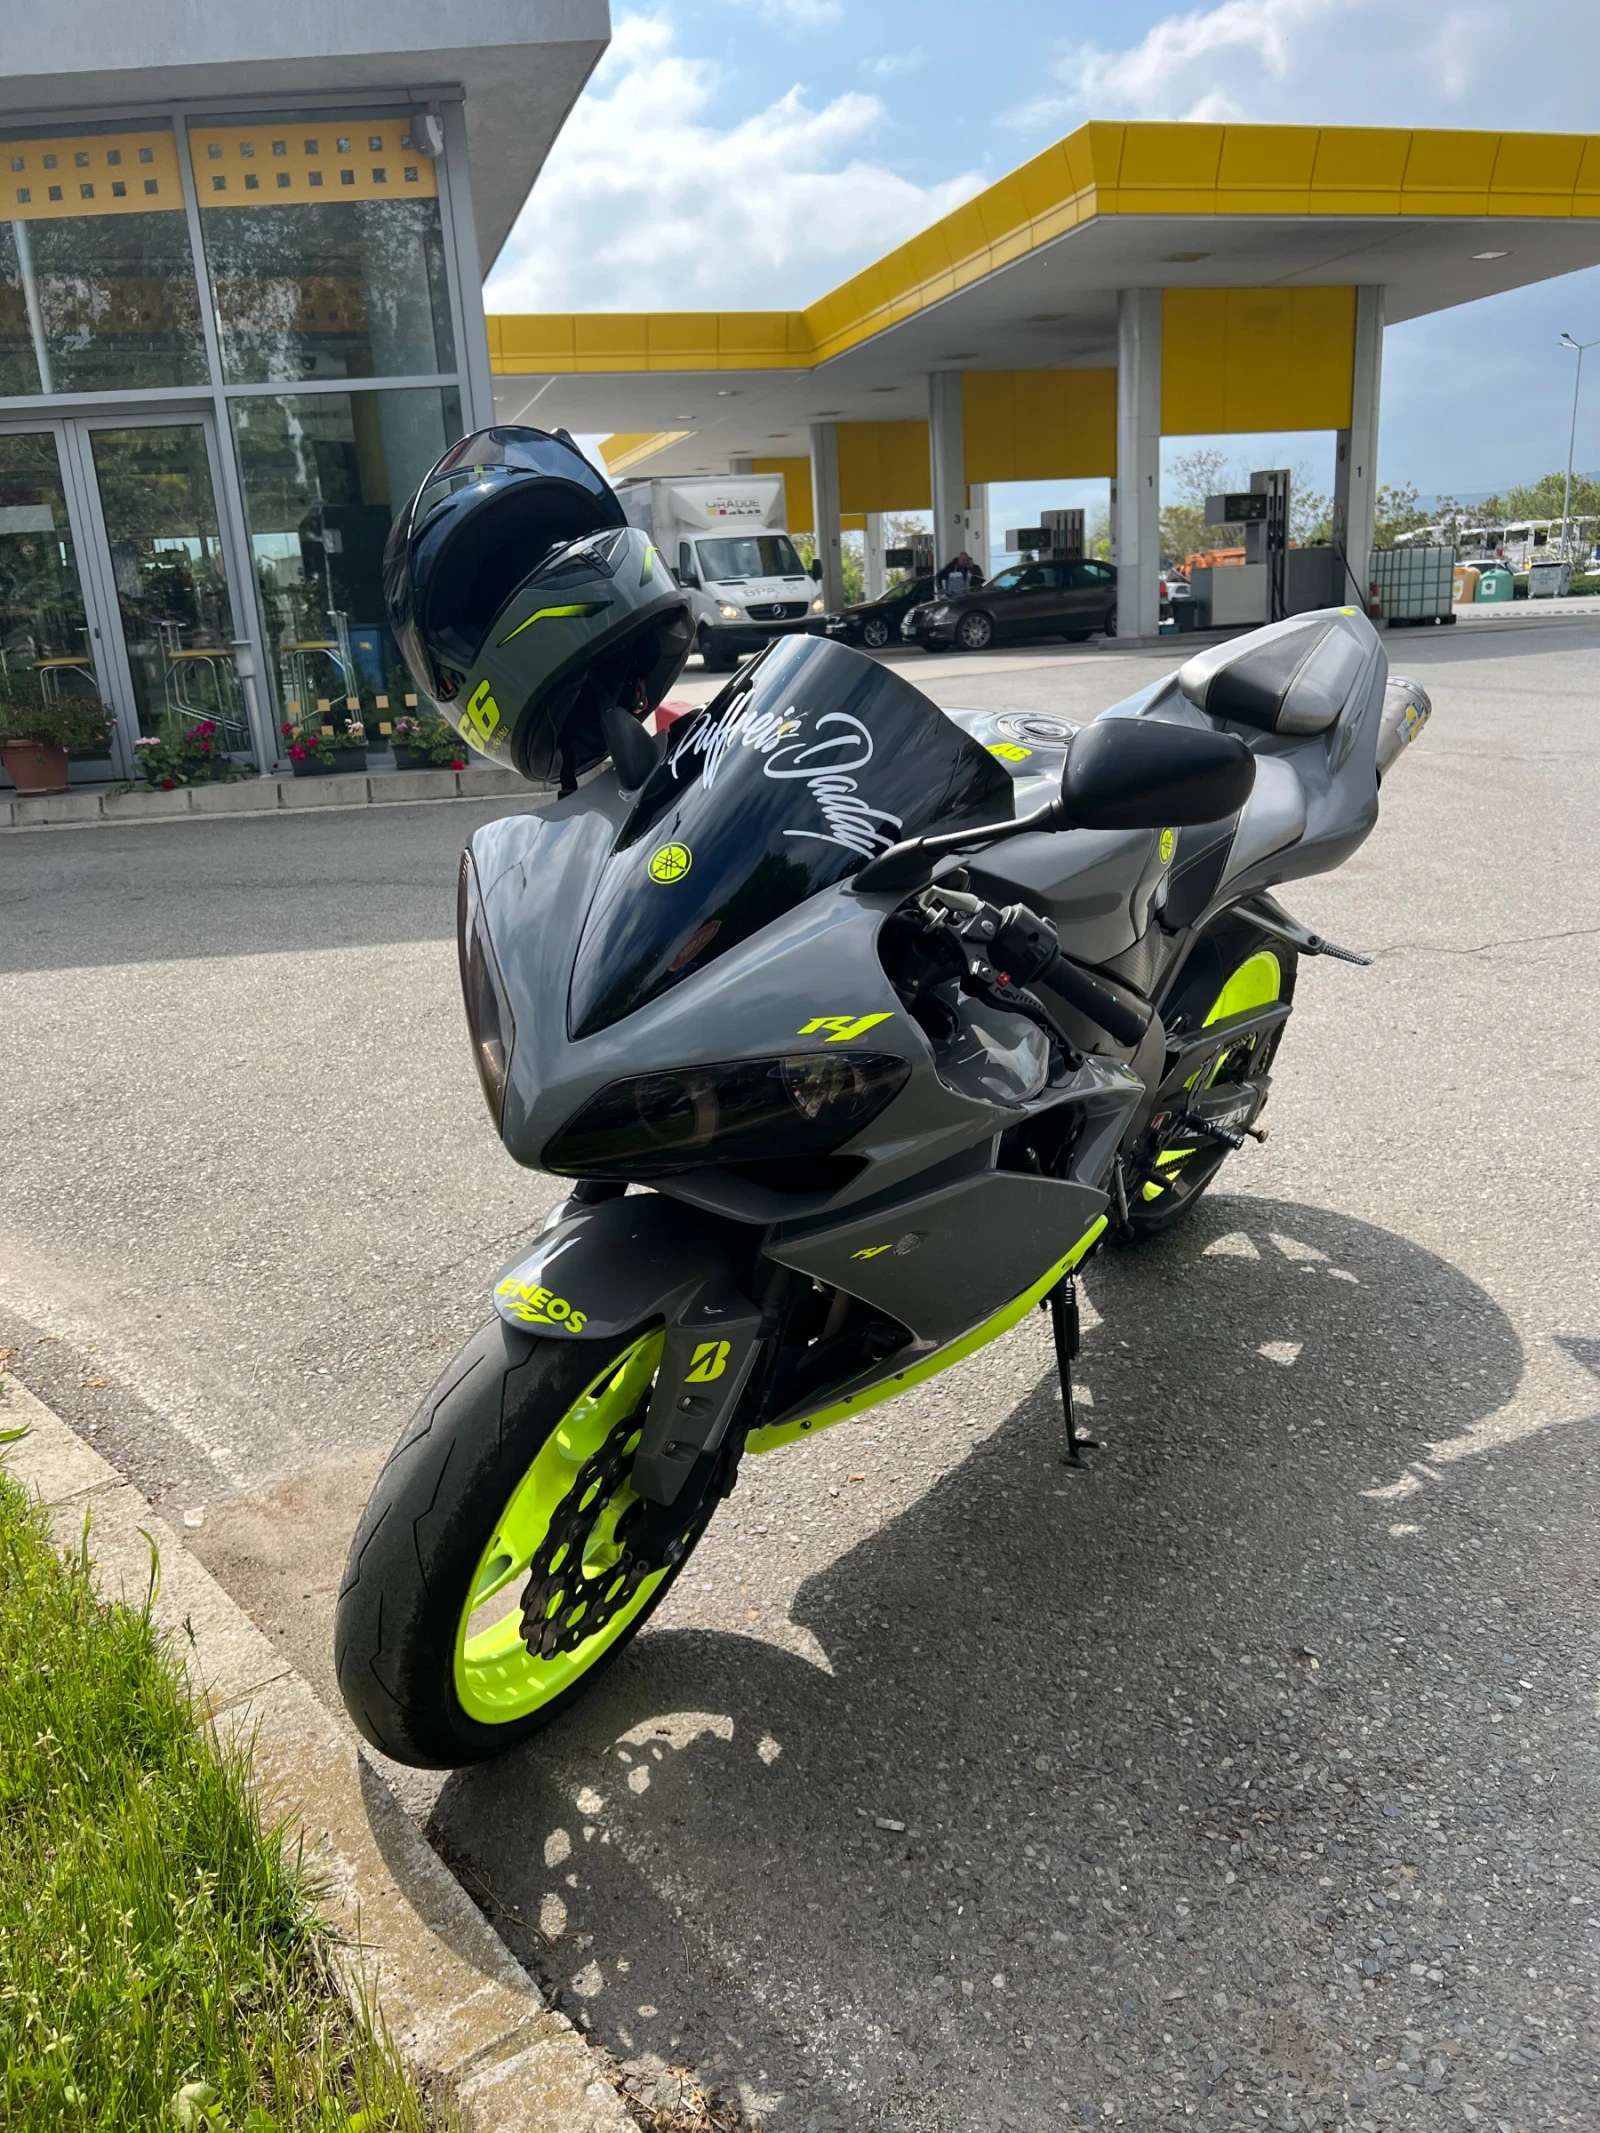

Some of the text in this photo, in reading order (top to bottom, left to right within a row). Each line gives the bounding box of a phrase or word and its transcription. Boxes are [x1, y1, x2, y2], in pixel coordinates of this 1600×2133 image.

[953, 514, 962, 525] 3
[986, 742, 1033, 762] 46
[763, 711, 903, 860] Daddy
[796, 1011, 895, 1043] R1
[495, 1277, 589, 1334] ENEOS
